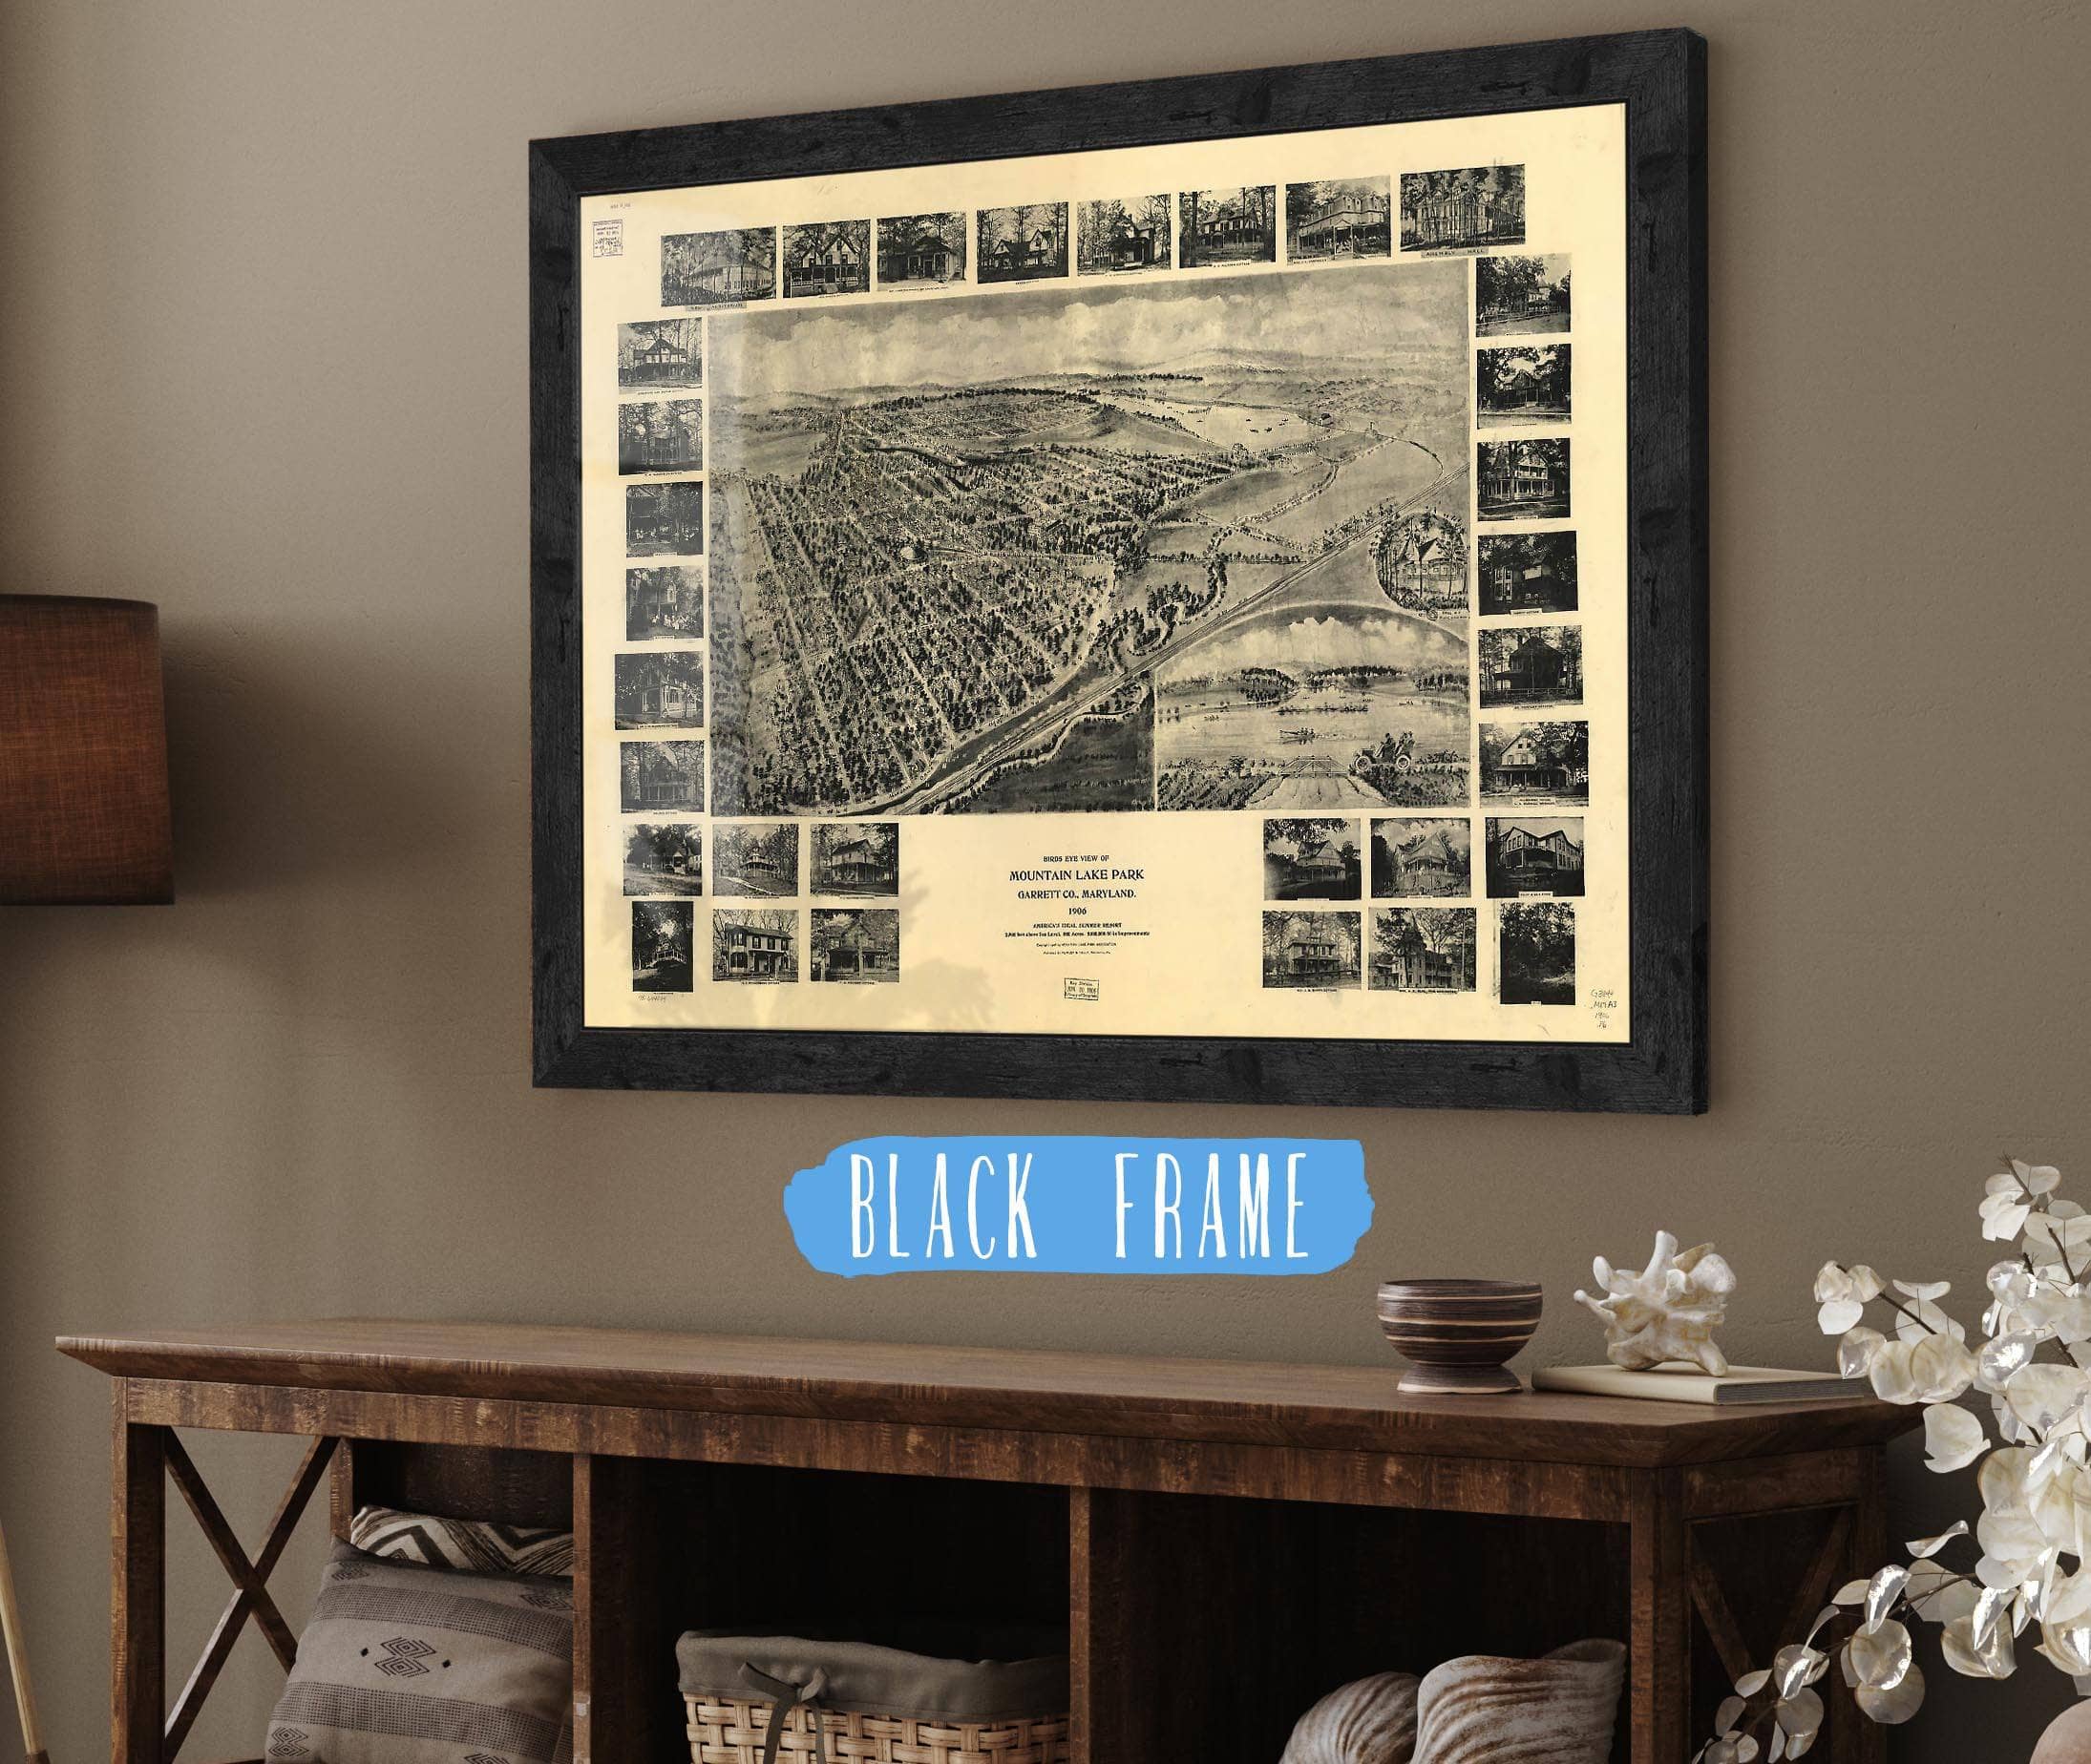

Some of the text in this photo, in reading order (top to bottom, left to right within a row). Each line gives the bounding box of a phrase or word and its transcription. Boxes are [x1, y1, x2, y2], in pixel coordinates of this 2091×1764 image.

[1065, 854, 1079, 863] EYE
[1080, 854, 1098, 863] VIEW
[1009, 869, 1145, 881] MOUNTAIN LAKE PARK
[1018, 890, 1061, 899] GARRETT
[1081, 889, 1137, 899] MARYLAND.
[1068, 907, 1088, 915] 1906
